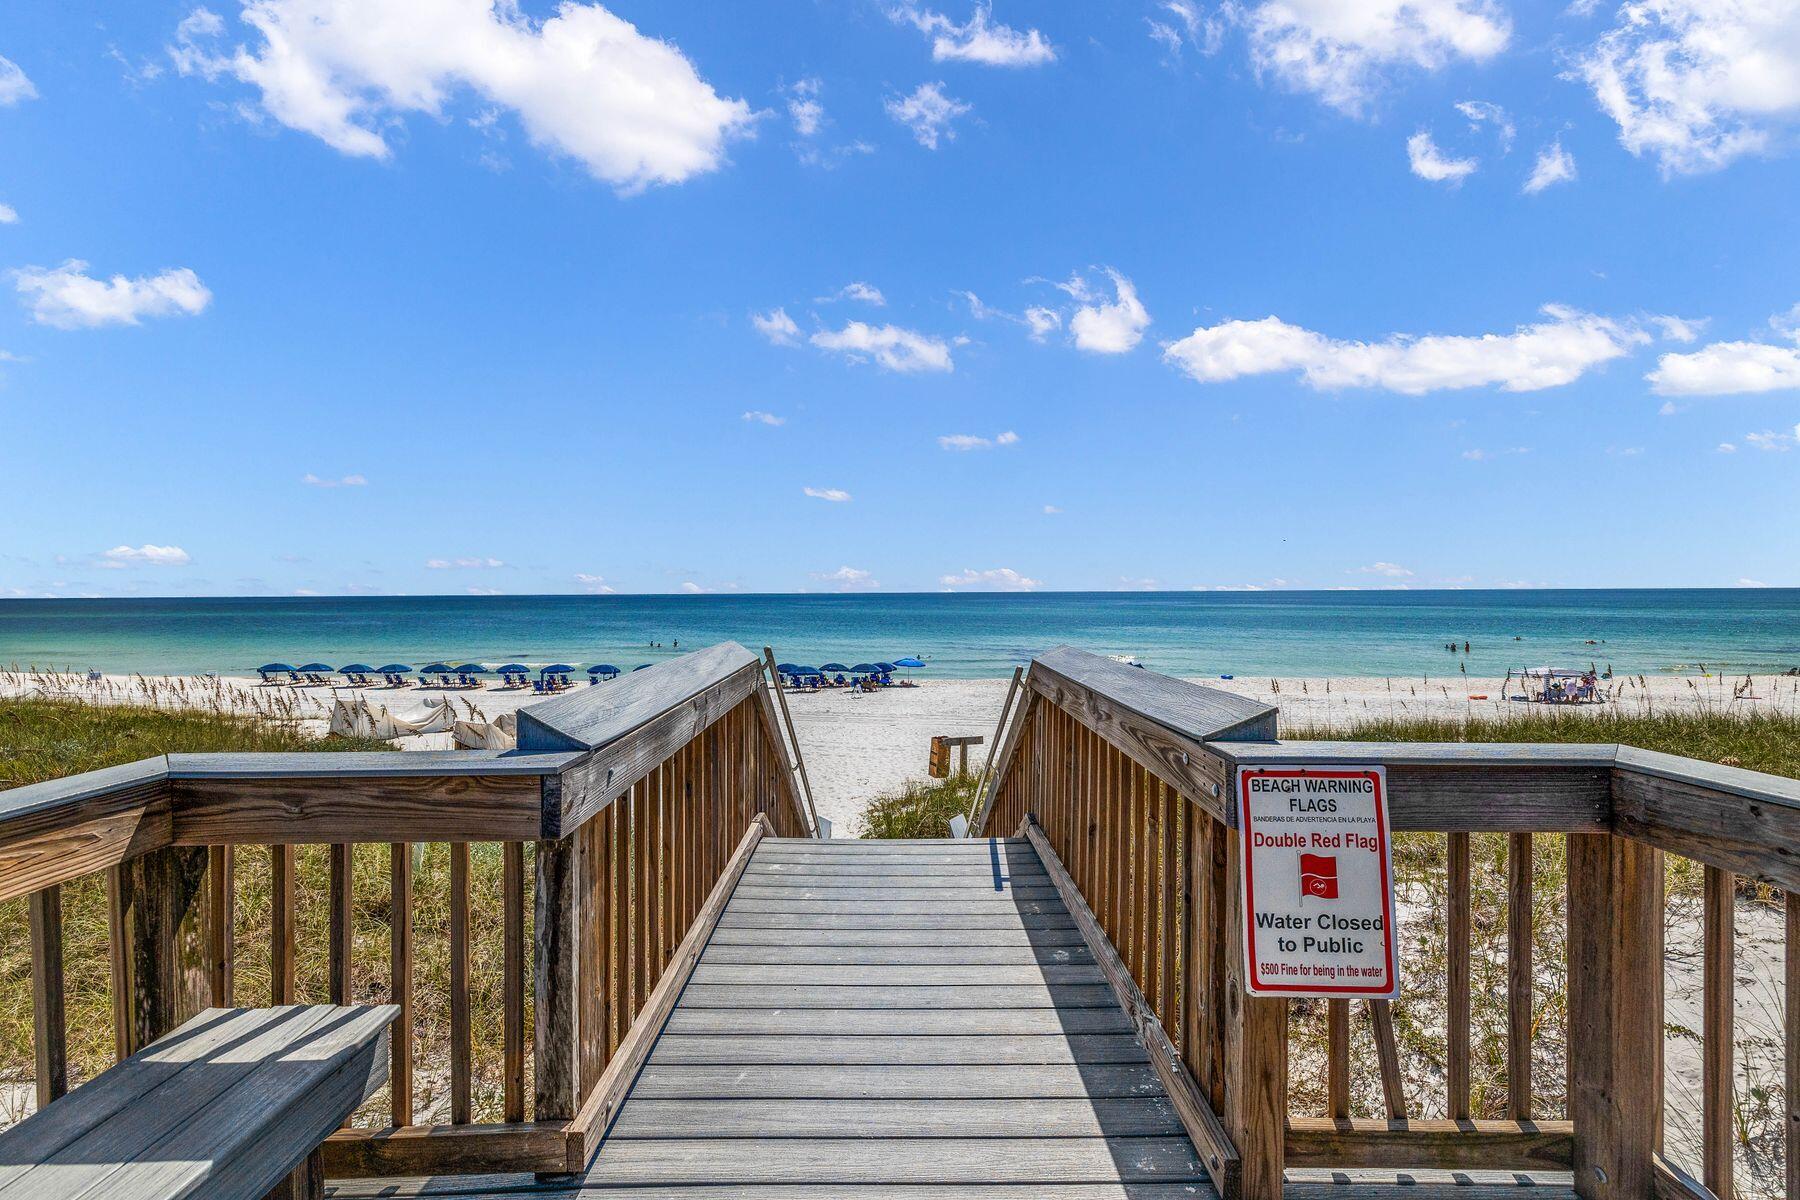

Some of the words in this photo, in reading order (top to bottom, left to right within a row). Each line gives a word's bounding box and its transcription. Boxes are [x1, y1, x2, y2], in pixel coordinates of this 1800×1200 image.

[1252, 779, 1300, 793] BEACH
[1305, 780, 1373, 793] WARNING
[1290, 799, 1337, 812] FLAGS
[1254, 832, 1306, 848] Double
[1311, 833, 1340, 848] Red
[1346, 833, 1378, 852] Flag
[1256, 913, 1311, 929] Water
[1317, 914, 1384, 931] Closed
[1278, 937, 1297, 952] to
[1304, 937, 1364, 953] Public
[1261, 963, 1279, 975] $500
[1281, 964, 1298, 976] Fine
[1300, 964, 1311, 976] for
[1313, 964, 1335, 979] being
[1337, 965, 1345, 976] in
[1347, 965, 1359, 977] the
[1361, 967, 1382, 977] water
